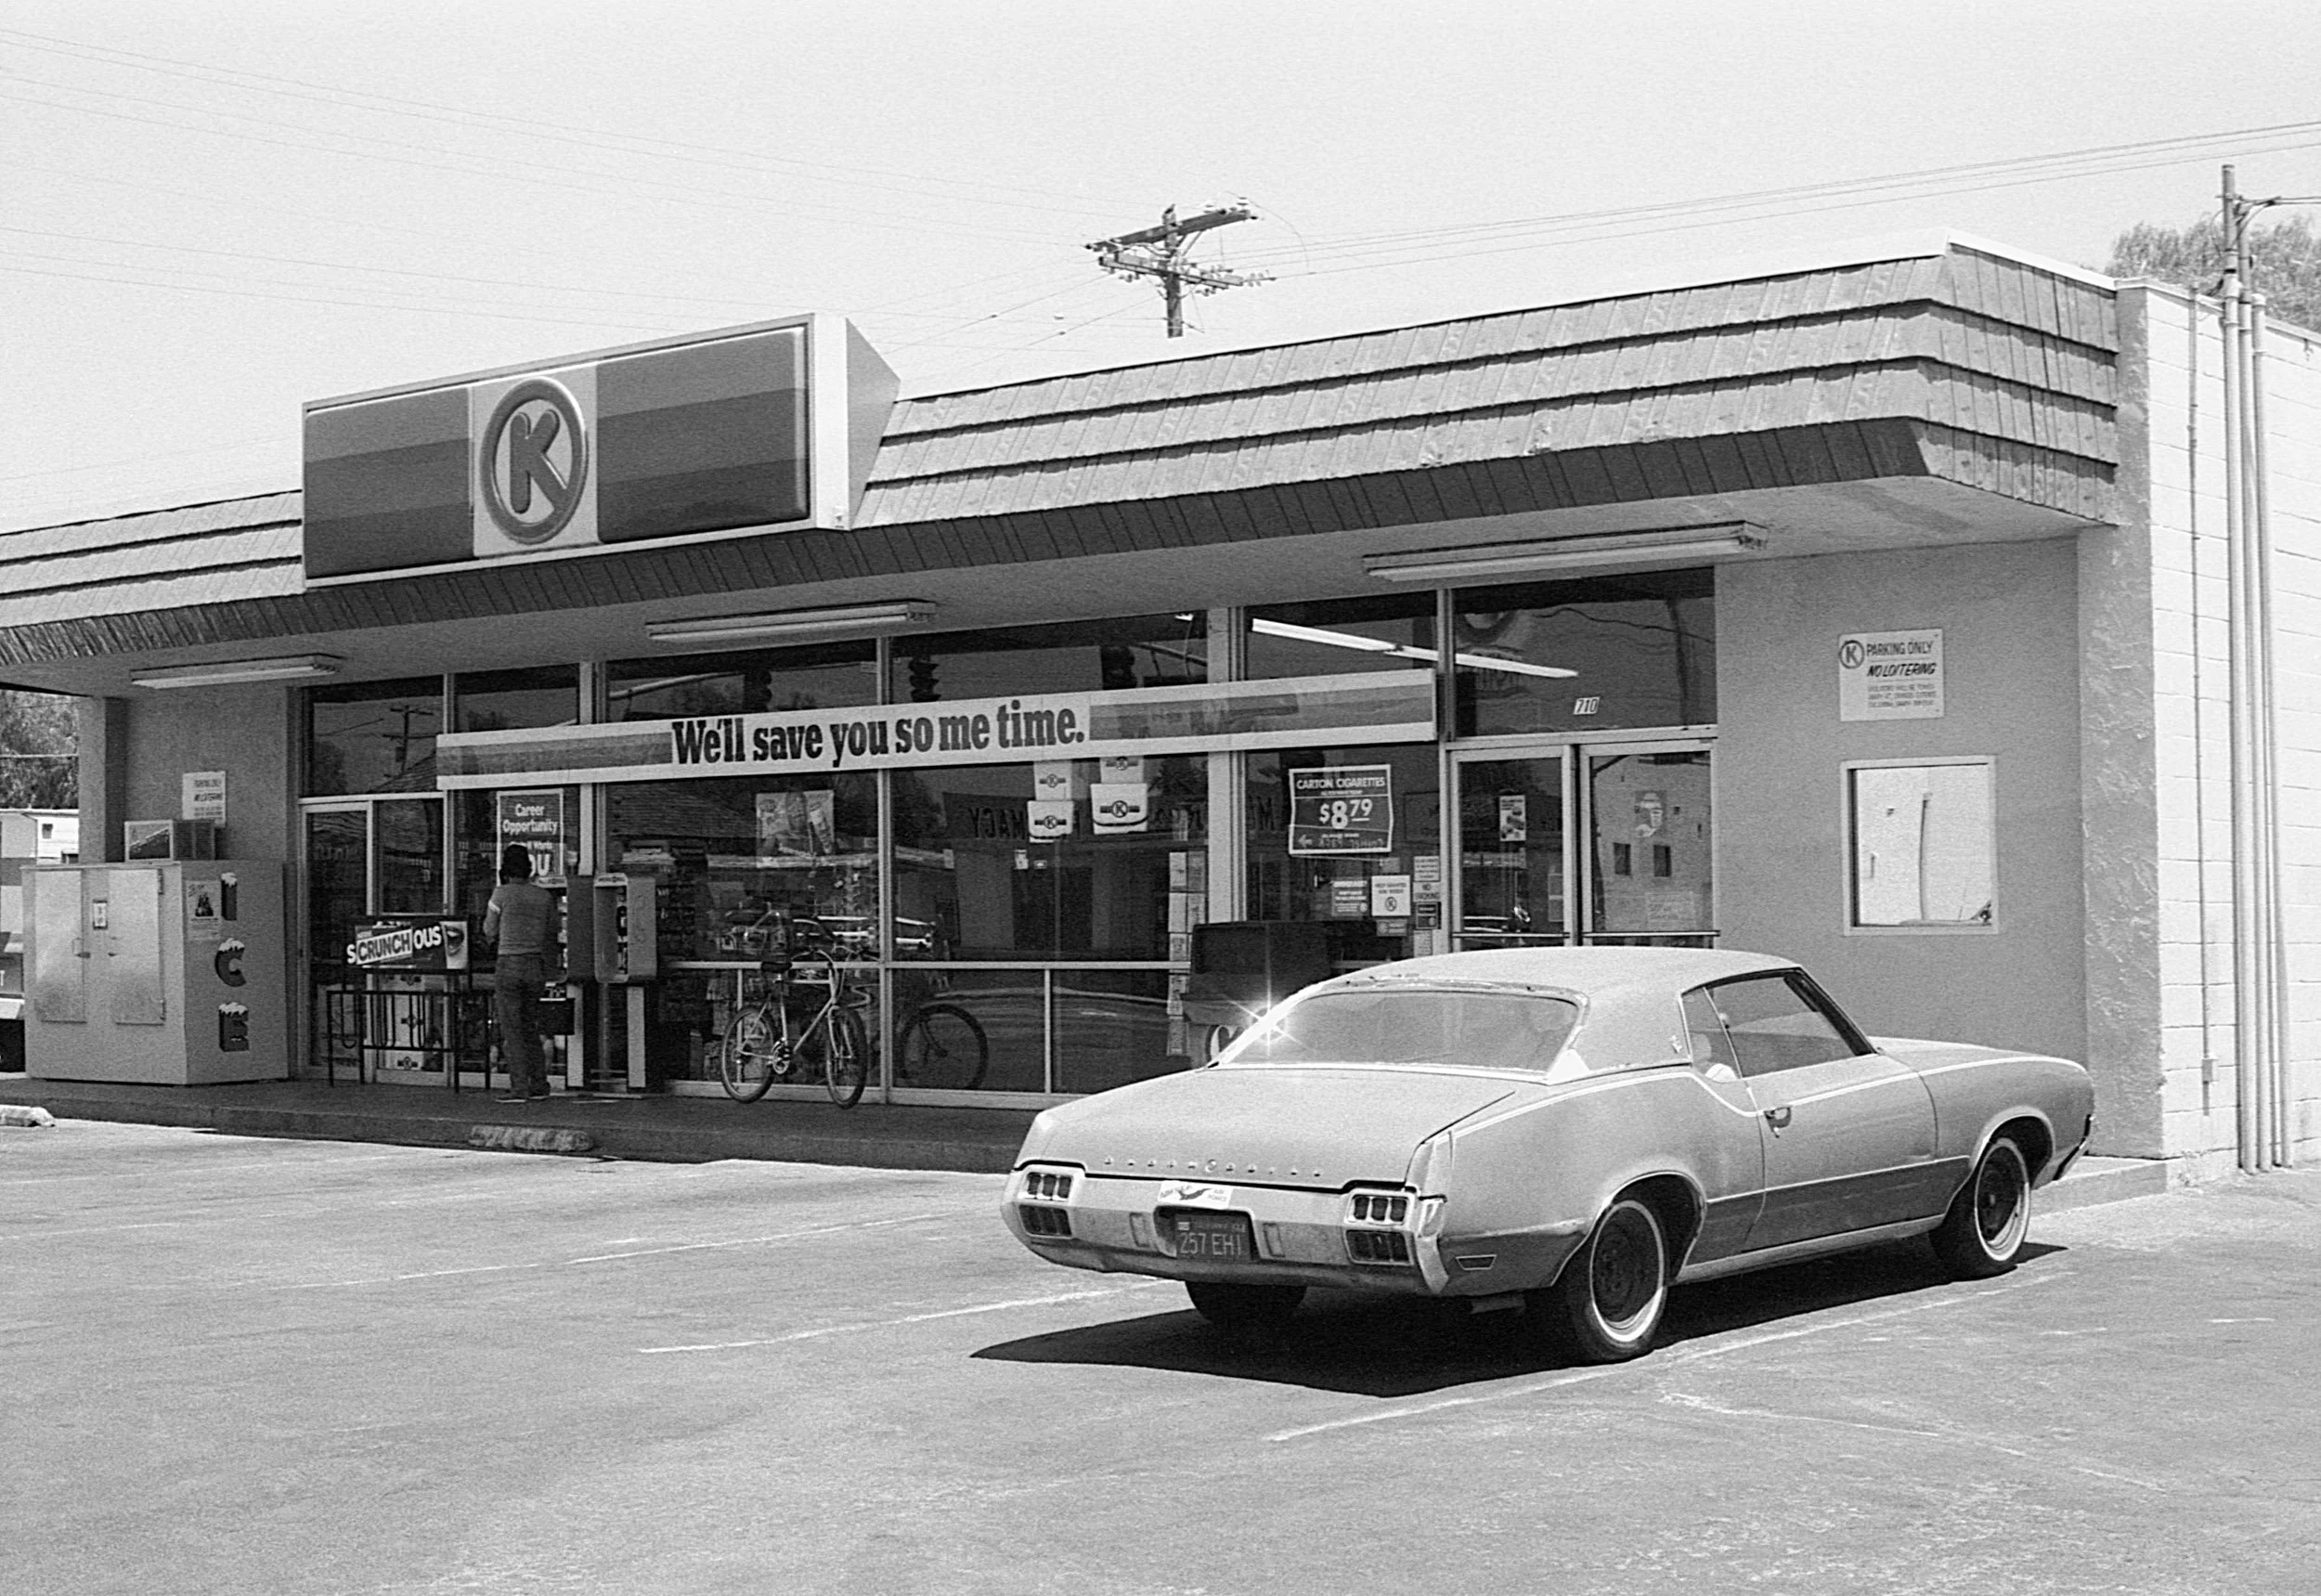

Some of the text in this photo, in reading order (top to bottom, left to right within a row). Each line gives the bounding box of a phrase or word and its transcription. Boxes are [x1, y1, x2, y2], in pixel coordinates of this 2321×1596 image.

[1866, 642, 1905, 655] PARKING
[1908, 641, 1933, 655] ONLY
[1867, 663, 1937, 677] NO LOITERING
[1576, 698, 1598, 712] 710
[672, 718, 746, 764] We'll
[753, 724, 823, 761] save
[830, 720, 888, 768] you
[996, 699, 1084, 749] time.
[1297, 777, 1385, 789] CARTON CIGARETTES
[515, 803, 544, 817] Career
[502, 819, 558, 835] Opportunity
[214, 872, 251, 1053] ICE
[1179, 1232, 1206, 1254] 257
